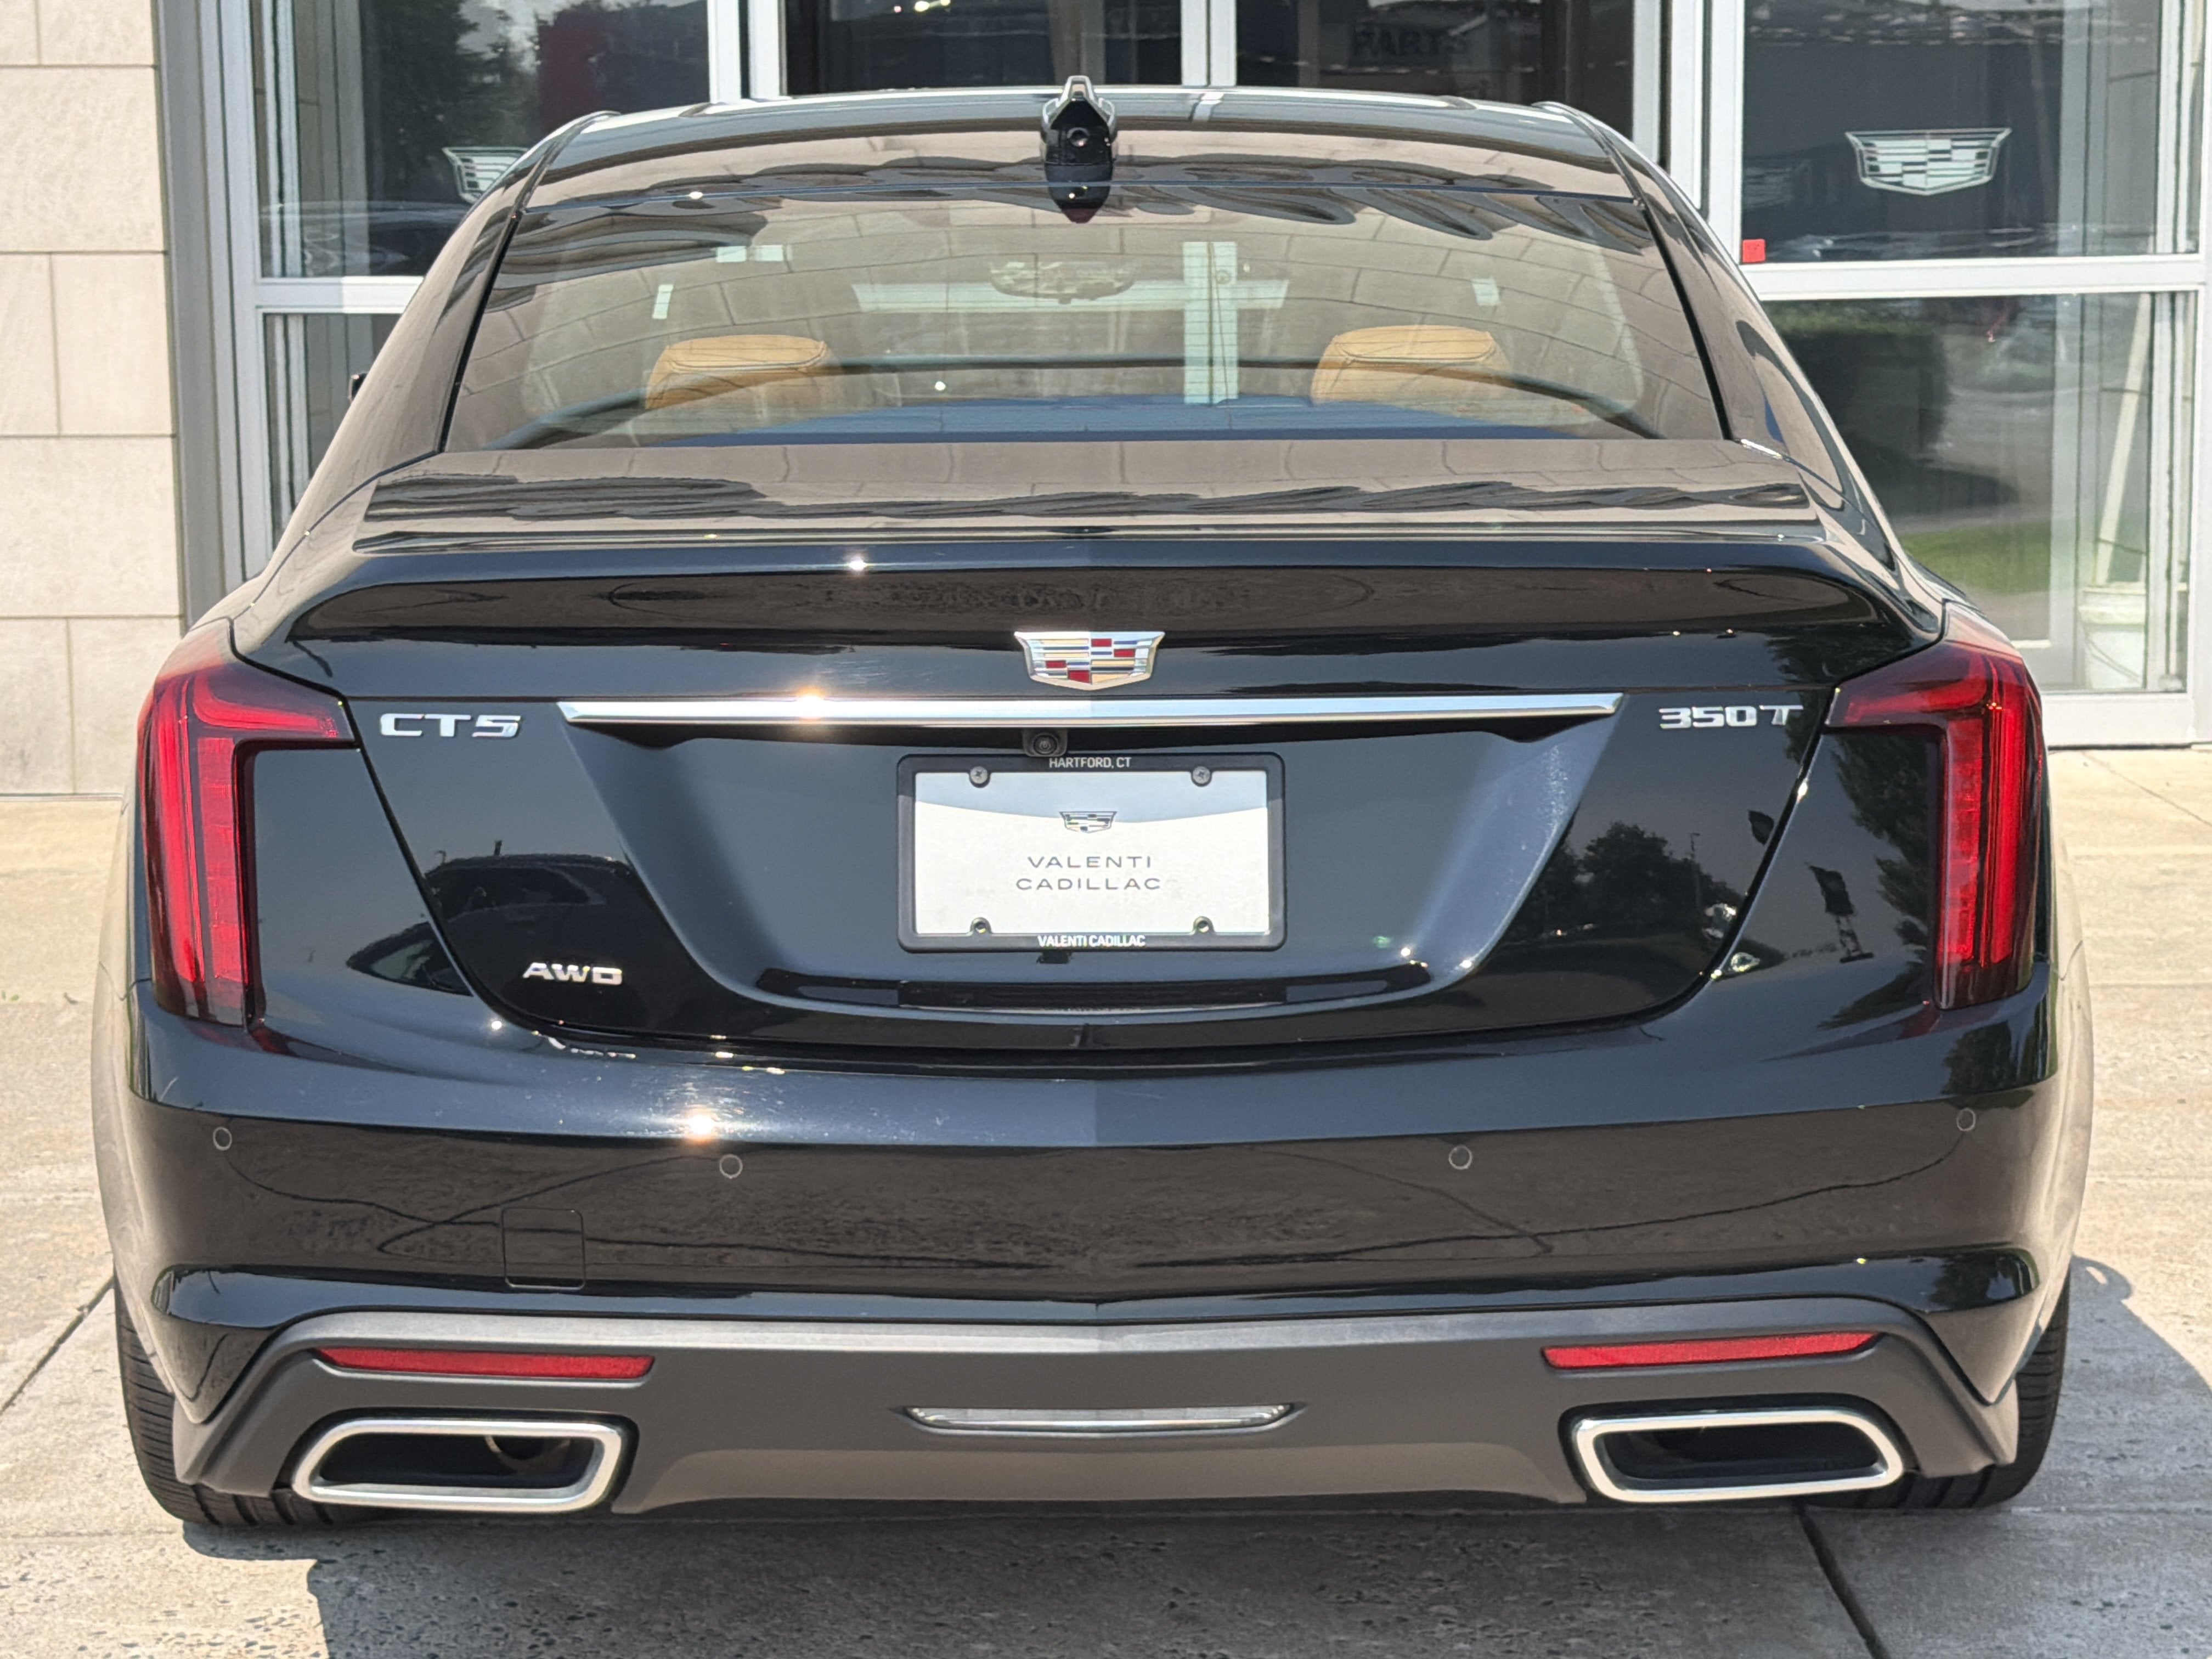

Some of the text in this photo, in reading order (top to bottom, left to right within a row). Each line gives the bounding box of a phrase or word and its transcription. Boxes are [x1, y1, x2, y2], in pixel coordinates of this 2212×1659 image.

[1048, 757, 1132, 769] HARTFORD, CT
[1027, 856, 1150, 868] VALENTI
[1015, 878, 1160, 890] CADILLAC
[1037, 935, 1146, 947] VALENTI CADILLAC
[522, 962, 622, 985] AWD
